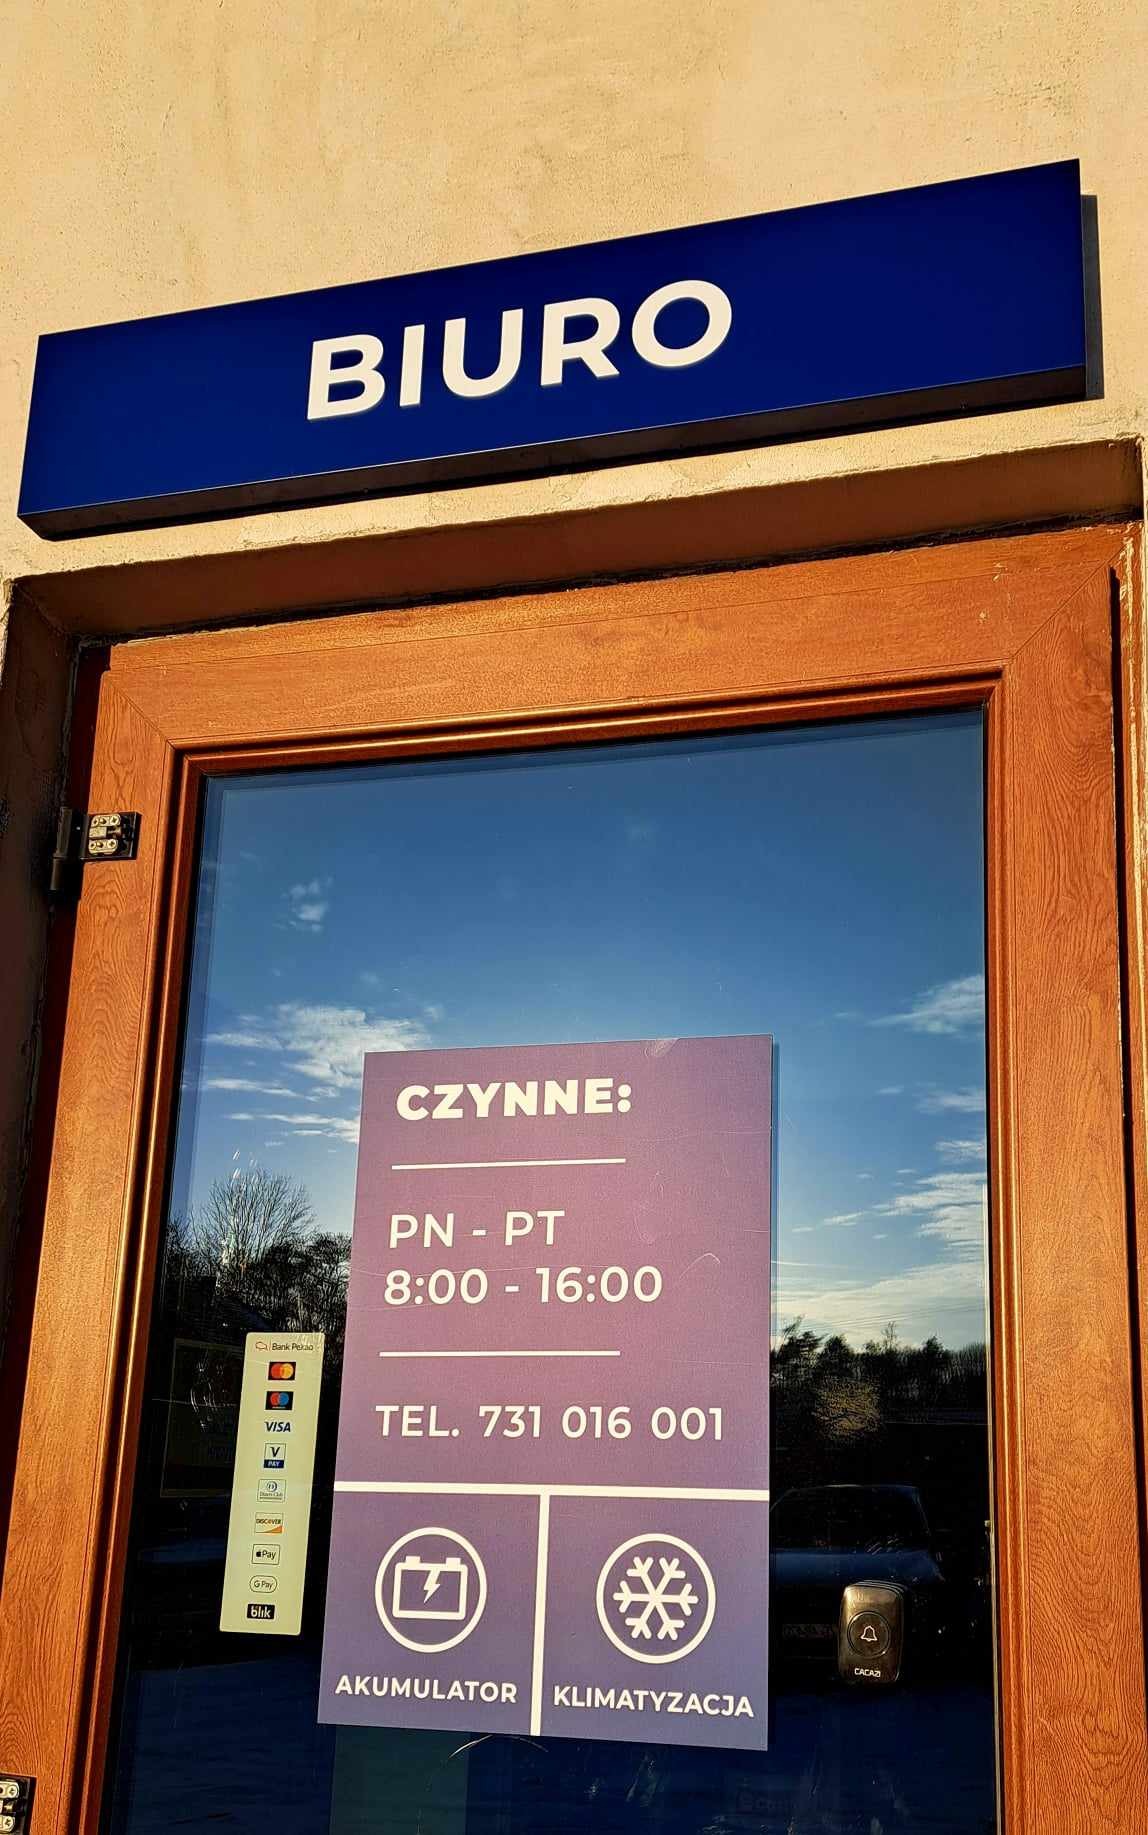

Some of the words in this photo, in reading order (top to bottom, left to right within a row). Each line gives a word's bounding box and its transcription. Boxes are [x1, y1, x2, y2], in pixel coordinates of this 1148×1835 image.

[307, 279, 733, 421] BIURO
[396, 1077, 632, 1121] CZYNNE:
[389, 1212, 455, 1249] PN
[504, 1210, 566, 1246] PT
[384, 1268, 488, 1305] 8:00
[504, 1285, 520, 1293] -
[535, 1265, 663, 1303] 16:00
[272, 1342, 291, 1351] Bank
[264, 1421, 291, 1432] VISA
[375, 1405, 460, 1437] TEL.
[478, 1405, 541, 1438] 731
[561, 1405, 632, 1439] 016
[651, 1406, 722, 1441] 001
[270, 1446, 281, 1457] V
[262, 1549, 277, 1560] Pay
[261, 1581, 274, 1591] Pay
[250, 1605, 271, 1618] blik
[854, 1668, 881, 1677] CACAZI
[335, 1674, 517, 1703] AKUMULATOR
[554, 1685, 754, 1718] KLIMATYZACJA
